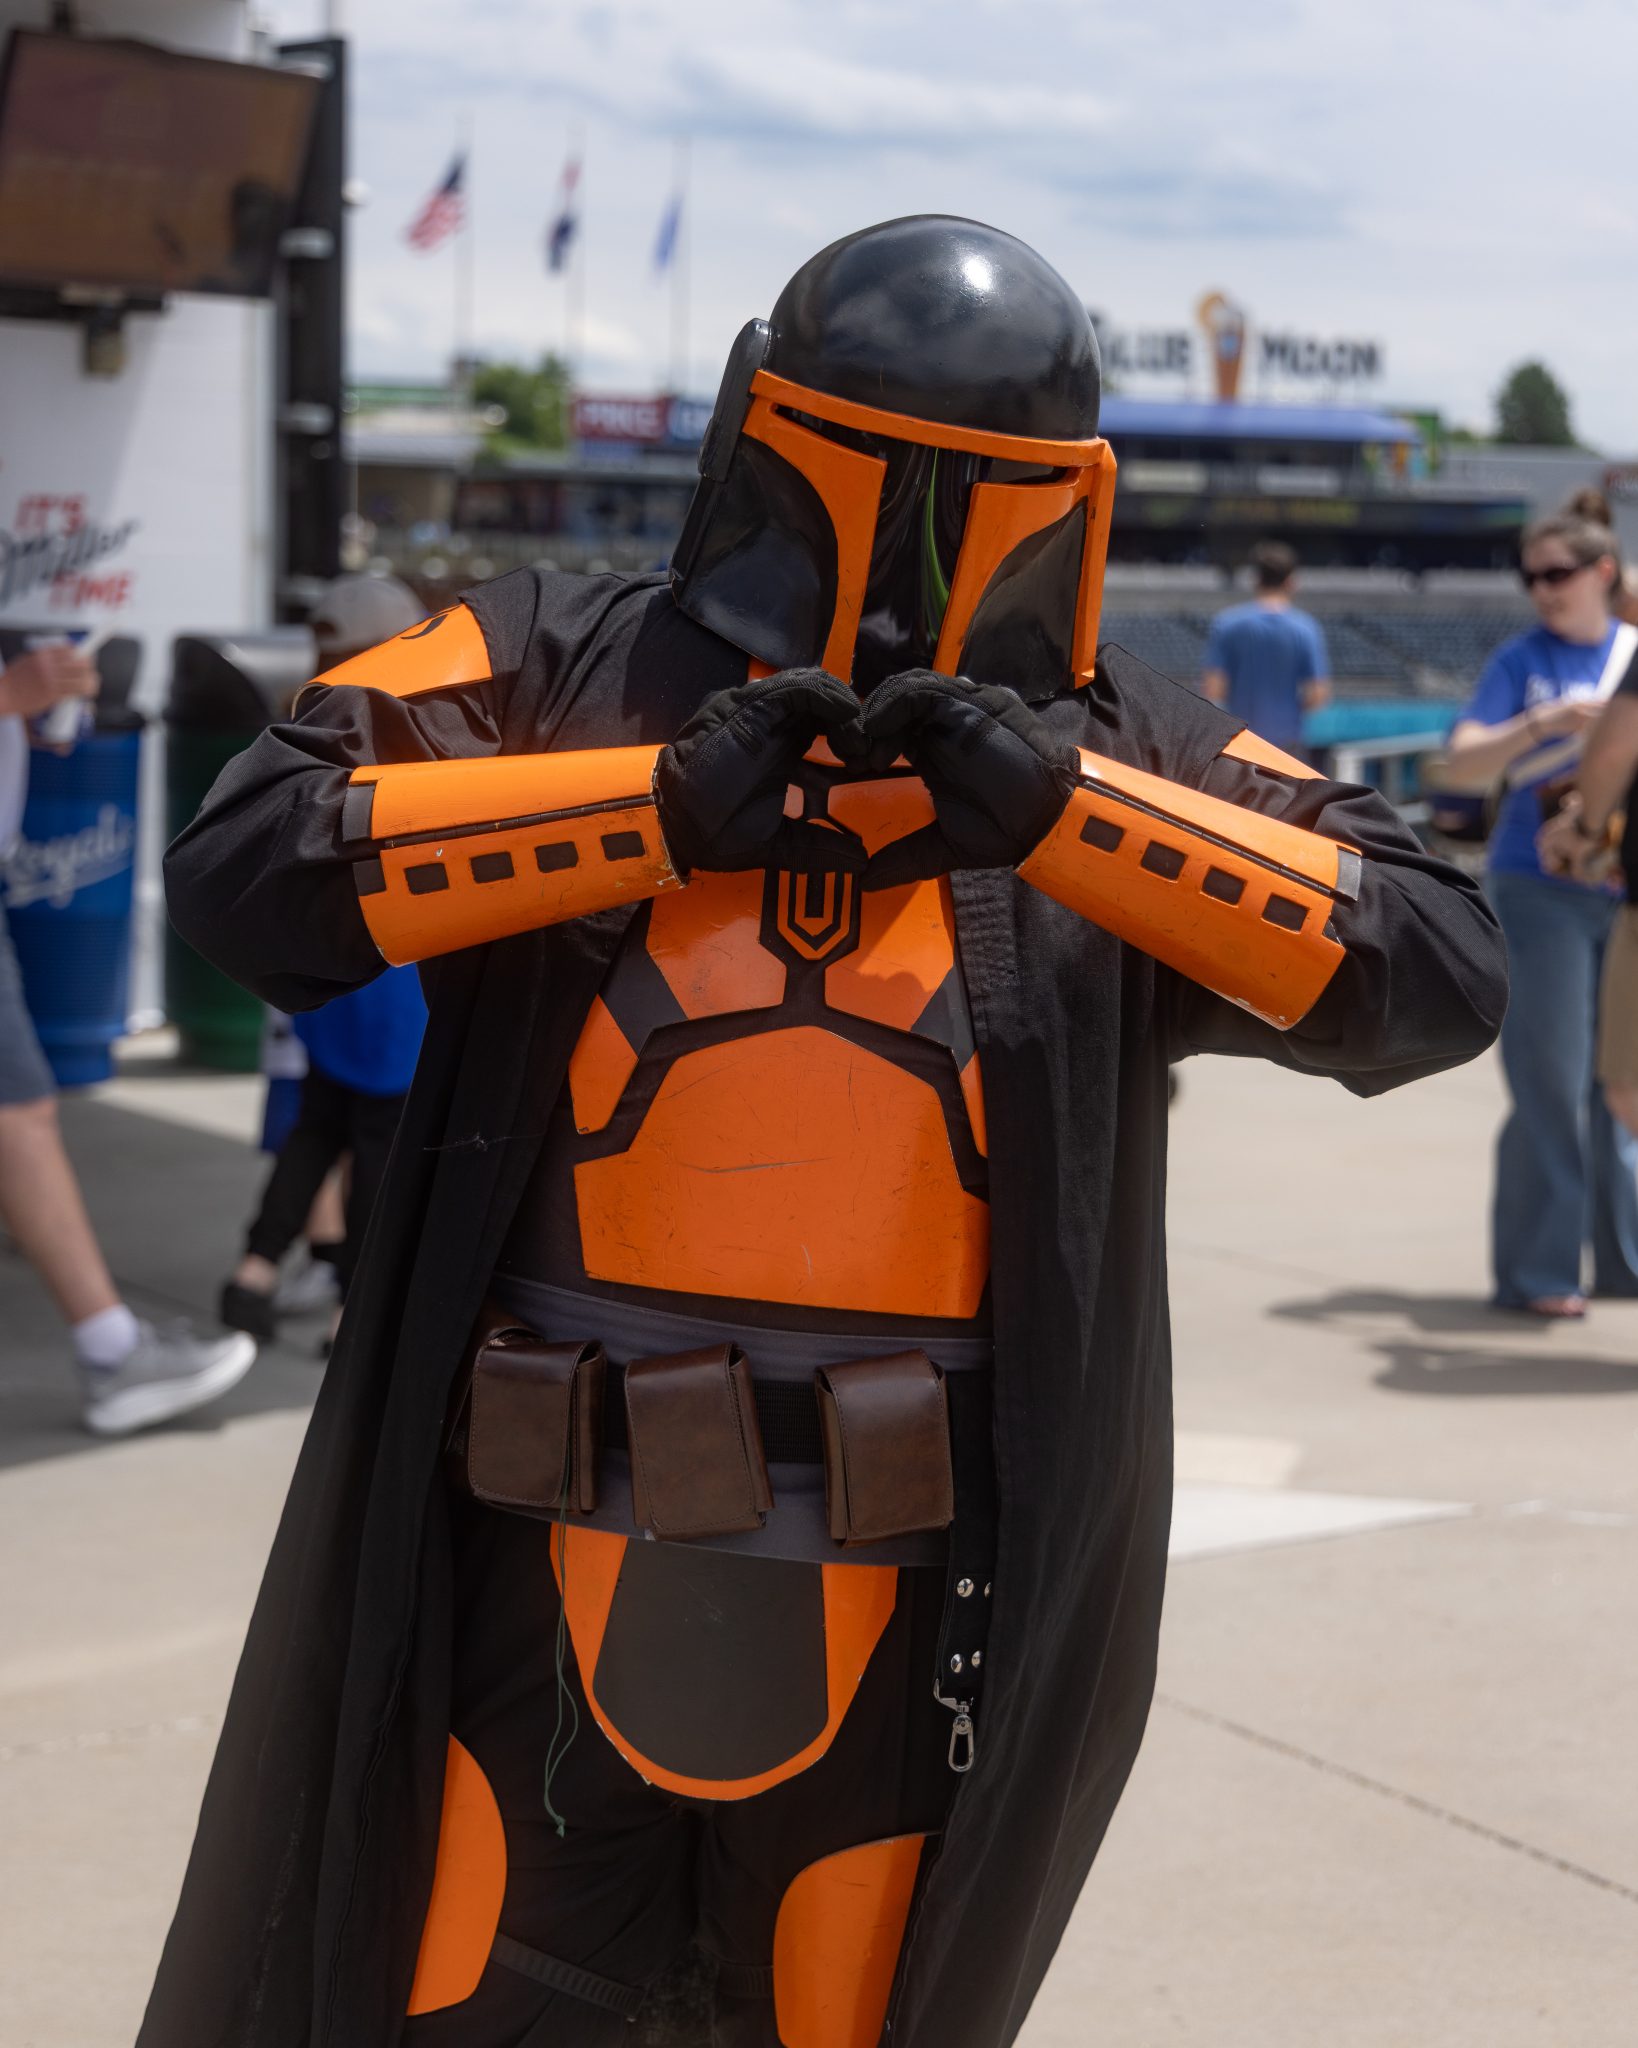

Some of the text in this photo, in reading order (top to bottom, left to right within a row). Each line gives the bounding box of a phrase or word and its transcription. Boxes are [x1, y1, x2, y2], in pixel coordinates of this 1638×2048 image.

[1258, 334, 1382, 377] MOON
[14, 494, 86, 537] IT'S
[50, 570, 133, 611] TIME
